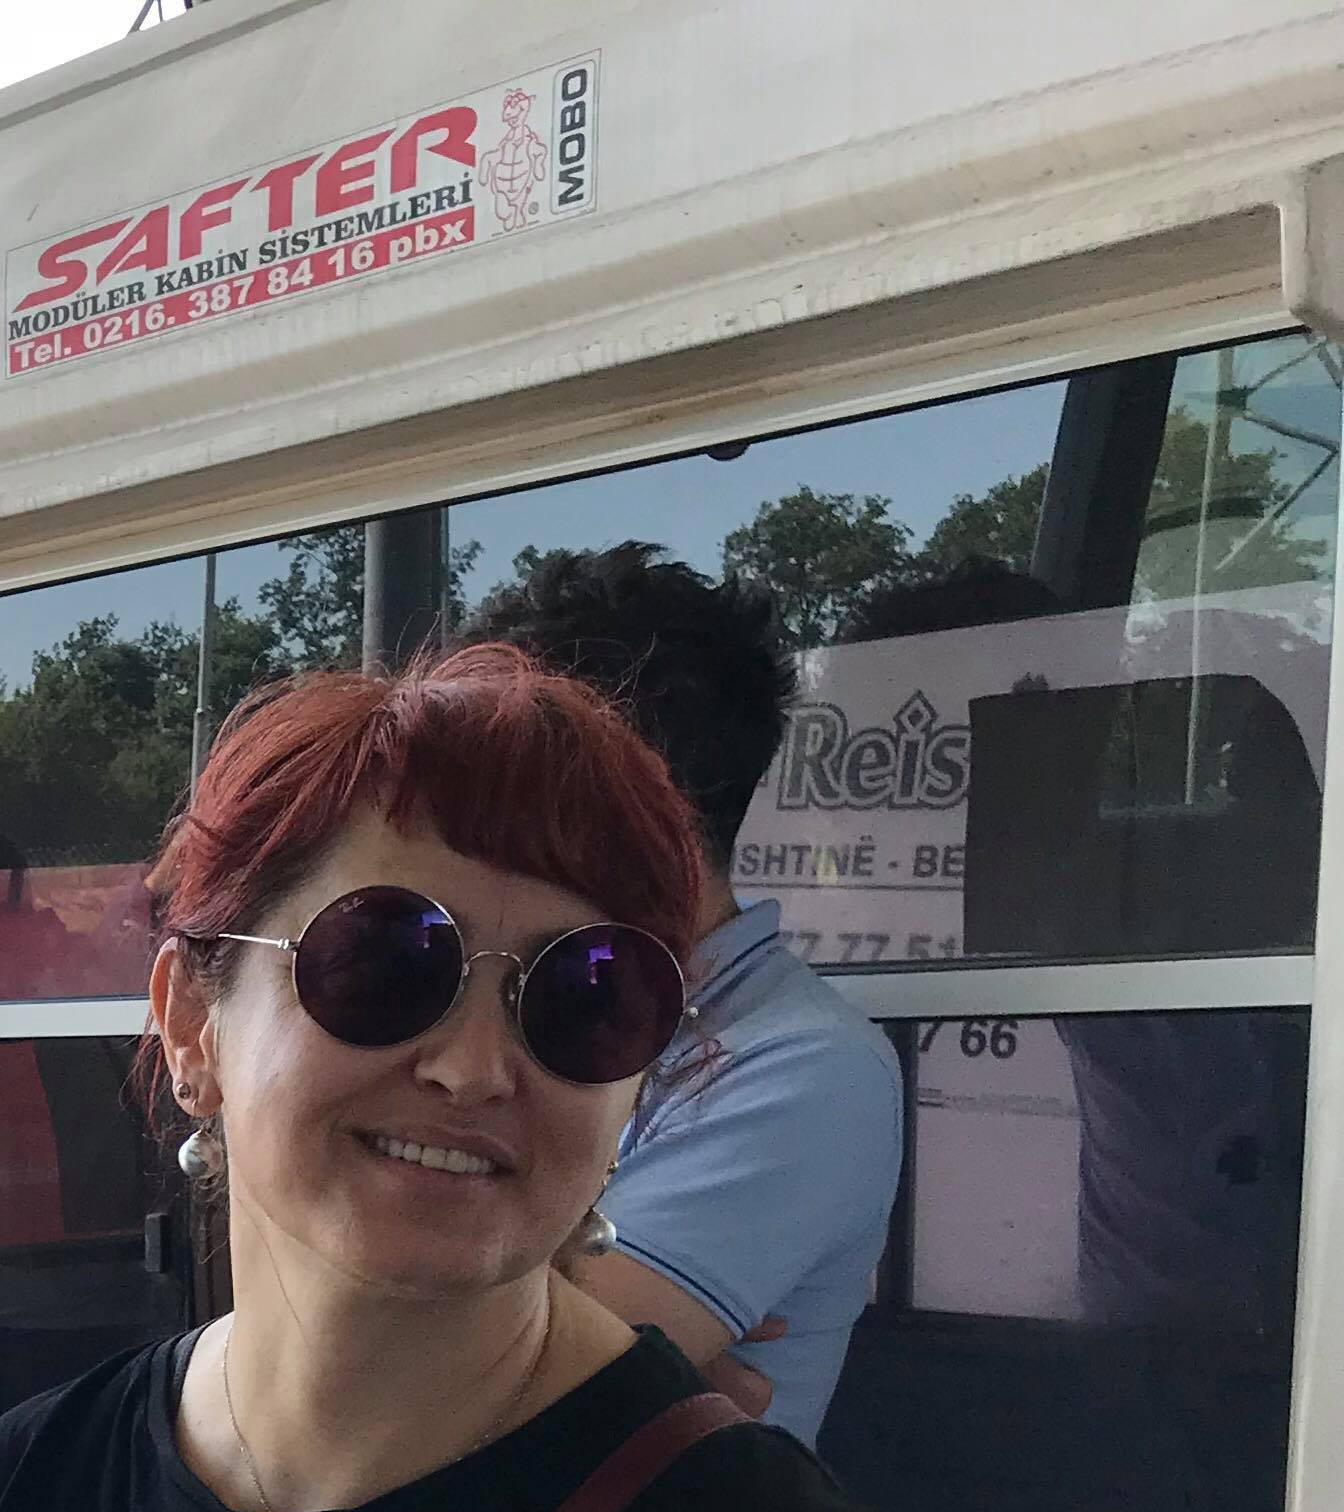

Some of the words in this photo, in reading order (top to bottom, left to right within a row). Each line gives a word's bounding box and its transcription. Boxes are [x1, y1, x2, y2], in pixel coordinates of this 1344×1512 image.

[557, 67, 589, 207] MOBO
[7, 281, 147, 341] MODÜLER
[154, 247, 250, 297] KABİN
[258, 170, 474, 266] SİSTEMLERİ
[12, 105, 479, 314] SAFTER
[14, 333, 73, 369] Tel.
[82, 303, 176, 350] 0216.
[187, 275, 256, 319] 387
[267, 257, 313, 296] 84
[327, 239, 376, 277] 16
[388, 217, 468, 266] pbx
[776, 689, 971, 811] Reis
[731, 835, 875, 877] SHTINË
[959, 1020, 1019, 1060] 66
